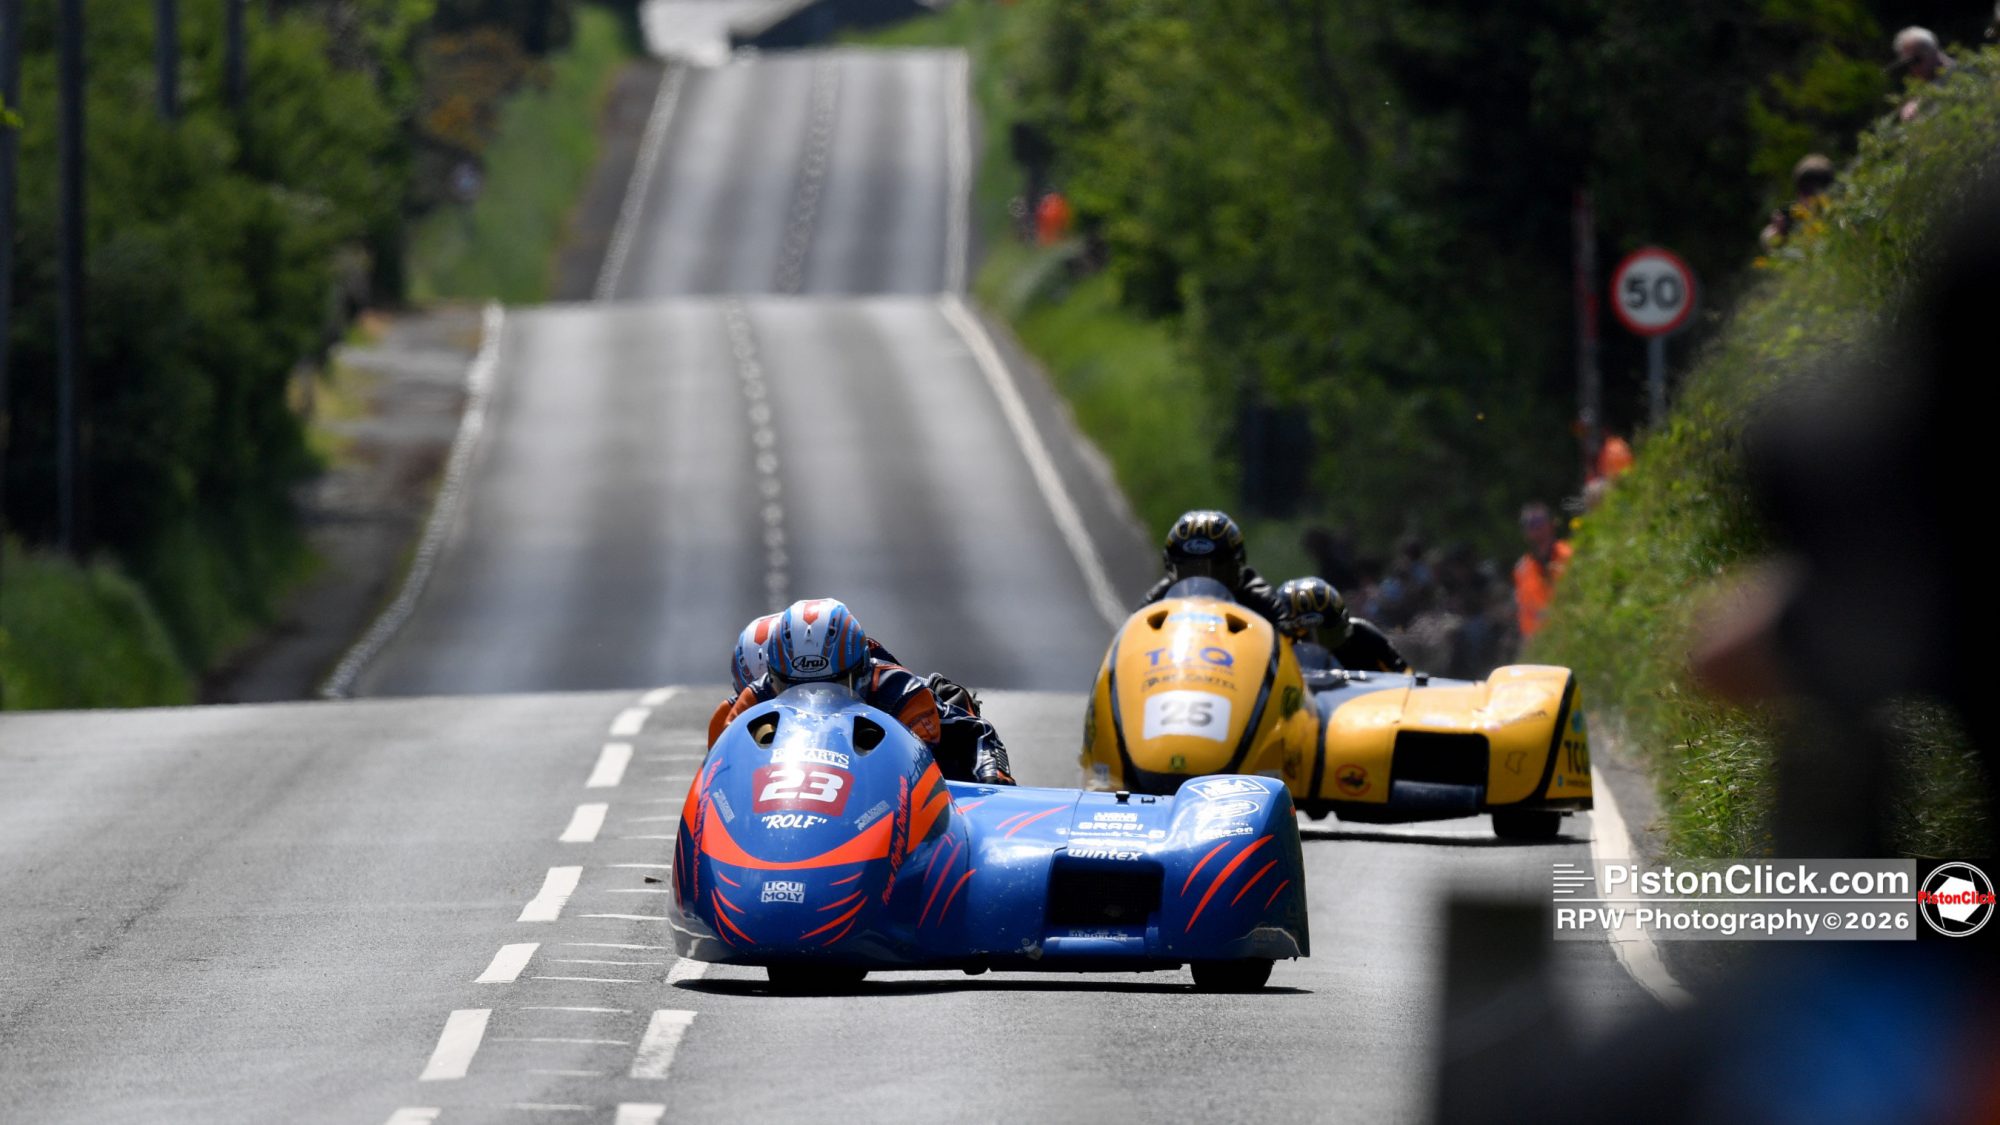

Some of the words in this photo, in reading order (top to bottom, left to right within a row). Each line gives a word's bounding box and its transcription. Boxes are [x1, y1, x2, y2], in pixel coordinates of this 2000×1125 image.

[1627, 274, 1682, 310] 50
[798, 656, 825, 669] Arai
[1161, 701, 1213, 728] 25
[758, 768, 844, 803] 23
[761, 813, 828, 829] "ROLF"
[764, 881, 804, 892] LIQUI
[763, 891, 803, 902] MOLY
